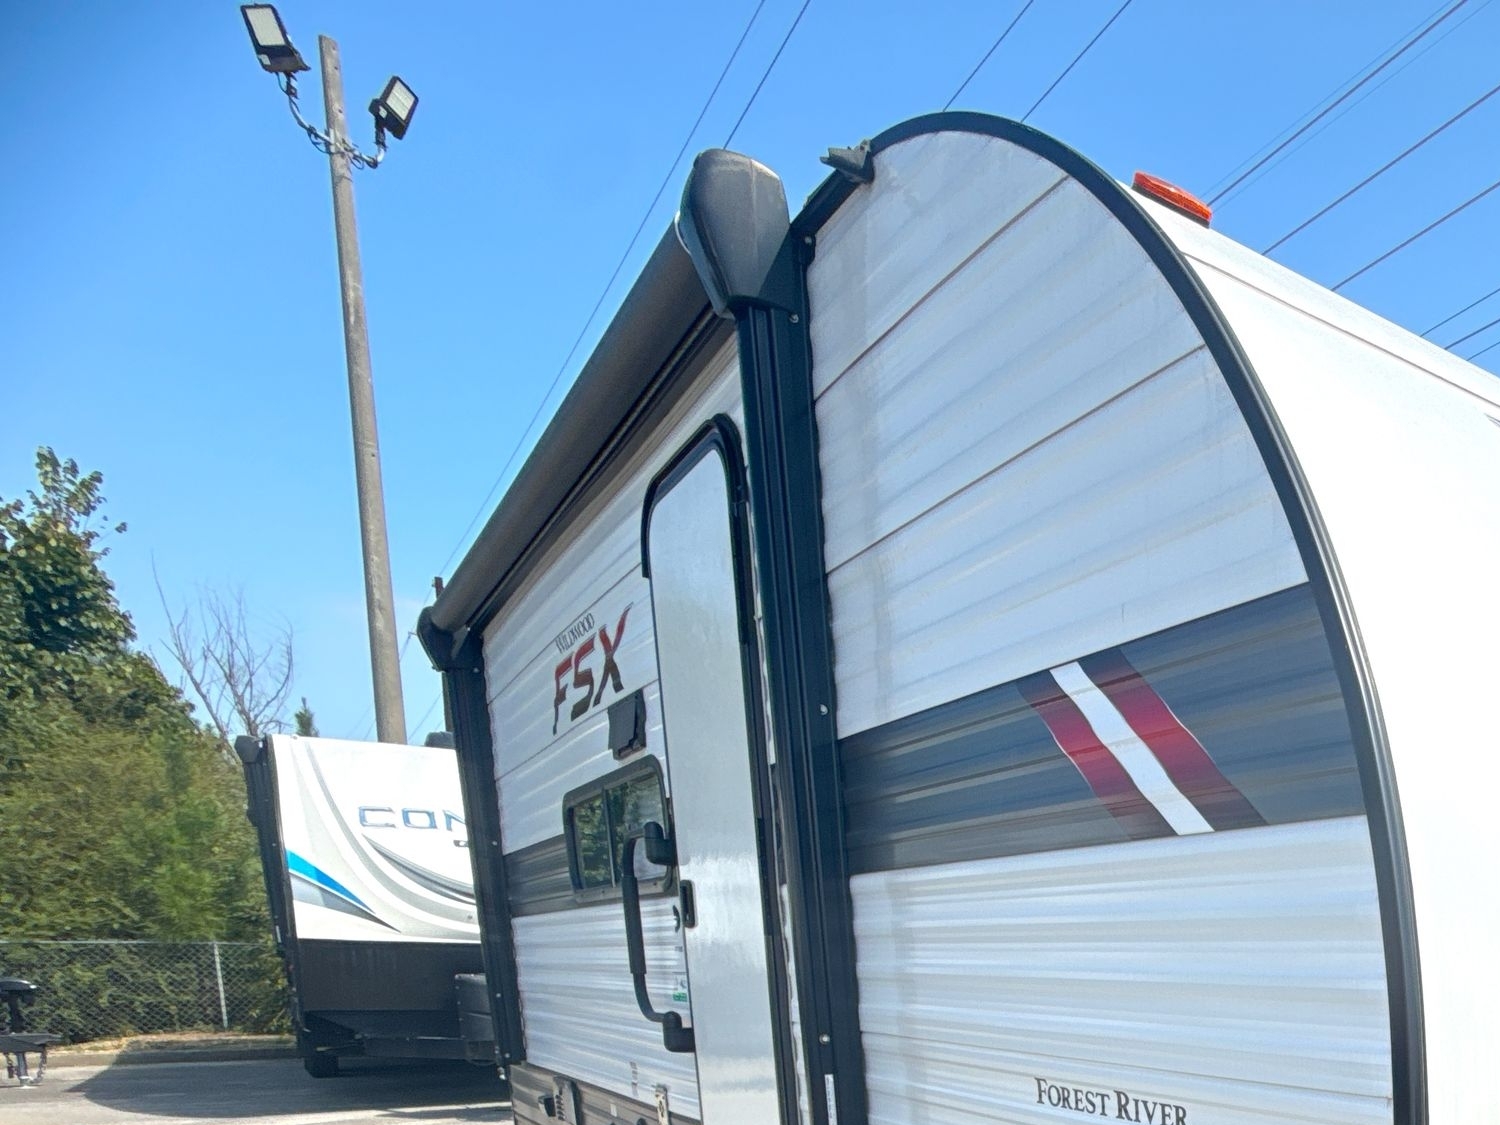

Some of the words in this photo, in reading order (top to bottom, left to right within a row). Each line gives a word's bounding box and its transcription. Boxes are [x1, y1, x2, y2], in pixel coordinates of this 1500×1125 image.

[555, 612, 595, 653] WILDWOOD
[553, 601, 634, 736] FSX
[1034, 1077, 1110, 1117] FOREST
